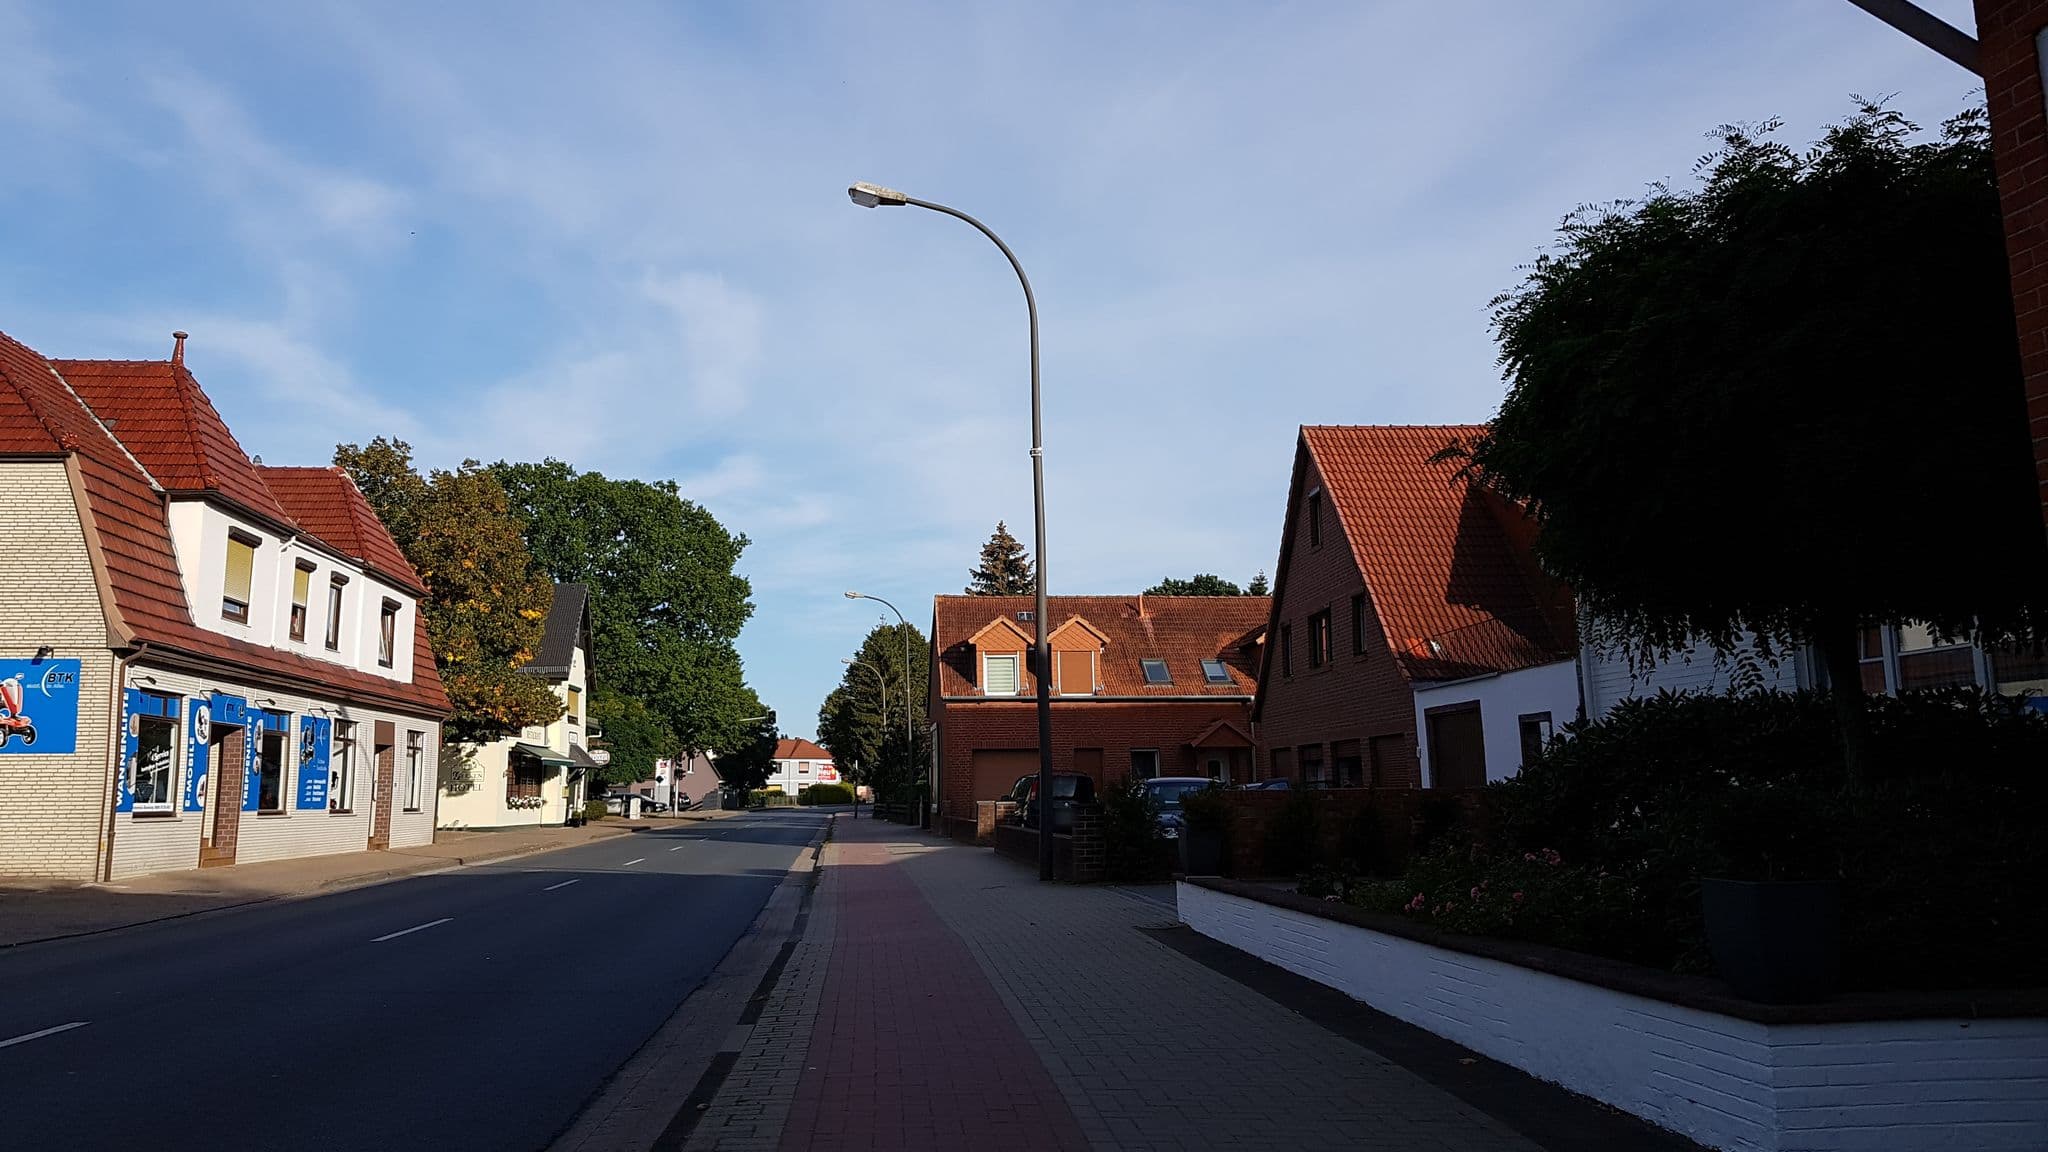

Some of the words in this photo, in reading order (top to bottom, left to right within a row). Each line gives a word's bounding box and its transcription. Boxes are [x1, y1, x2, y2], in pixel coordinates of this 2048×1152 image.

[47, 672, 74, 683] BTK
[116, 692, 129, 807] WANNENLIFTE
[184, 737, 195, 807] E-MOBILE
[242, 716, 252, 807] TREPPENLIFTE
[449, 783, 483, 791] HOTEL
